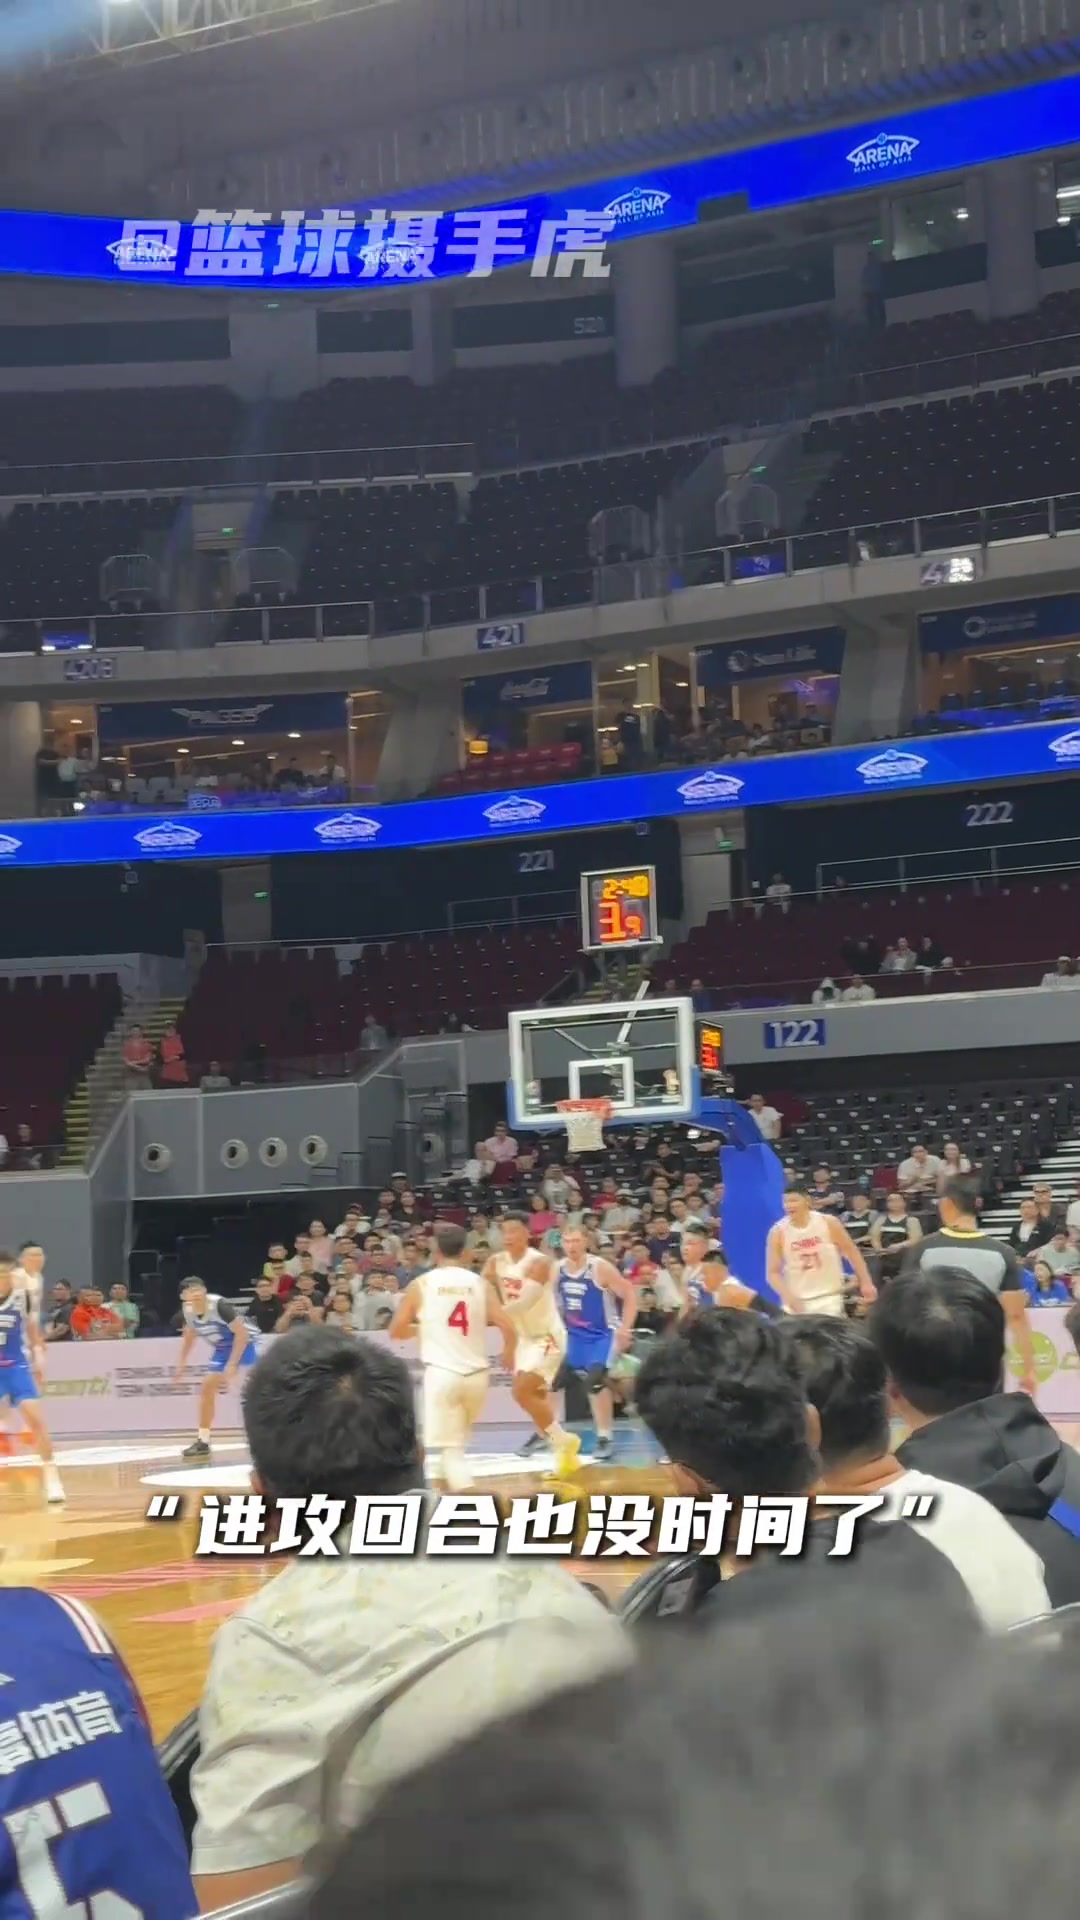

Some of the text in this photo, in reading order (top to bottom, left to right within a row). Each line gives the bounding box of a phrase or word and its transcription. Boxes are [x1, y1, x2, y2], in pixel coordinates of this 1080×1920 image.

[854, 141, 911, 167] ARENA
[612, 195, 664, 218] ARENA
[482, 624, 520, 648] 421
[966, 801, 1013, 827] 222
[518, 850, 554, 873] 221
[769, 1020, 819, 1048] 122
[448, 1300, 469, 1336] 4
